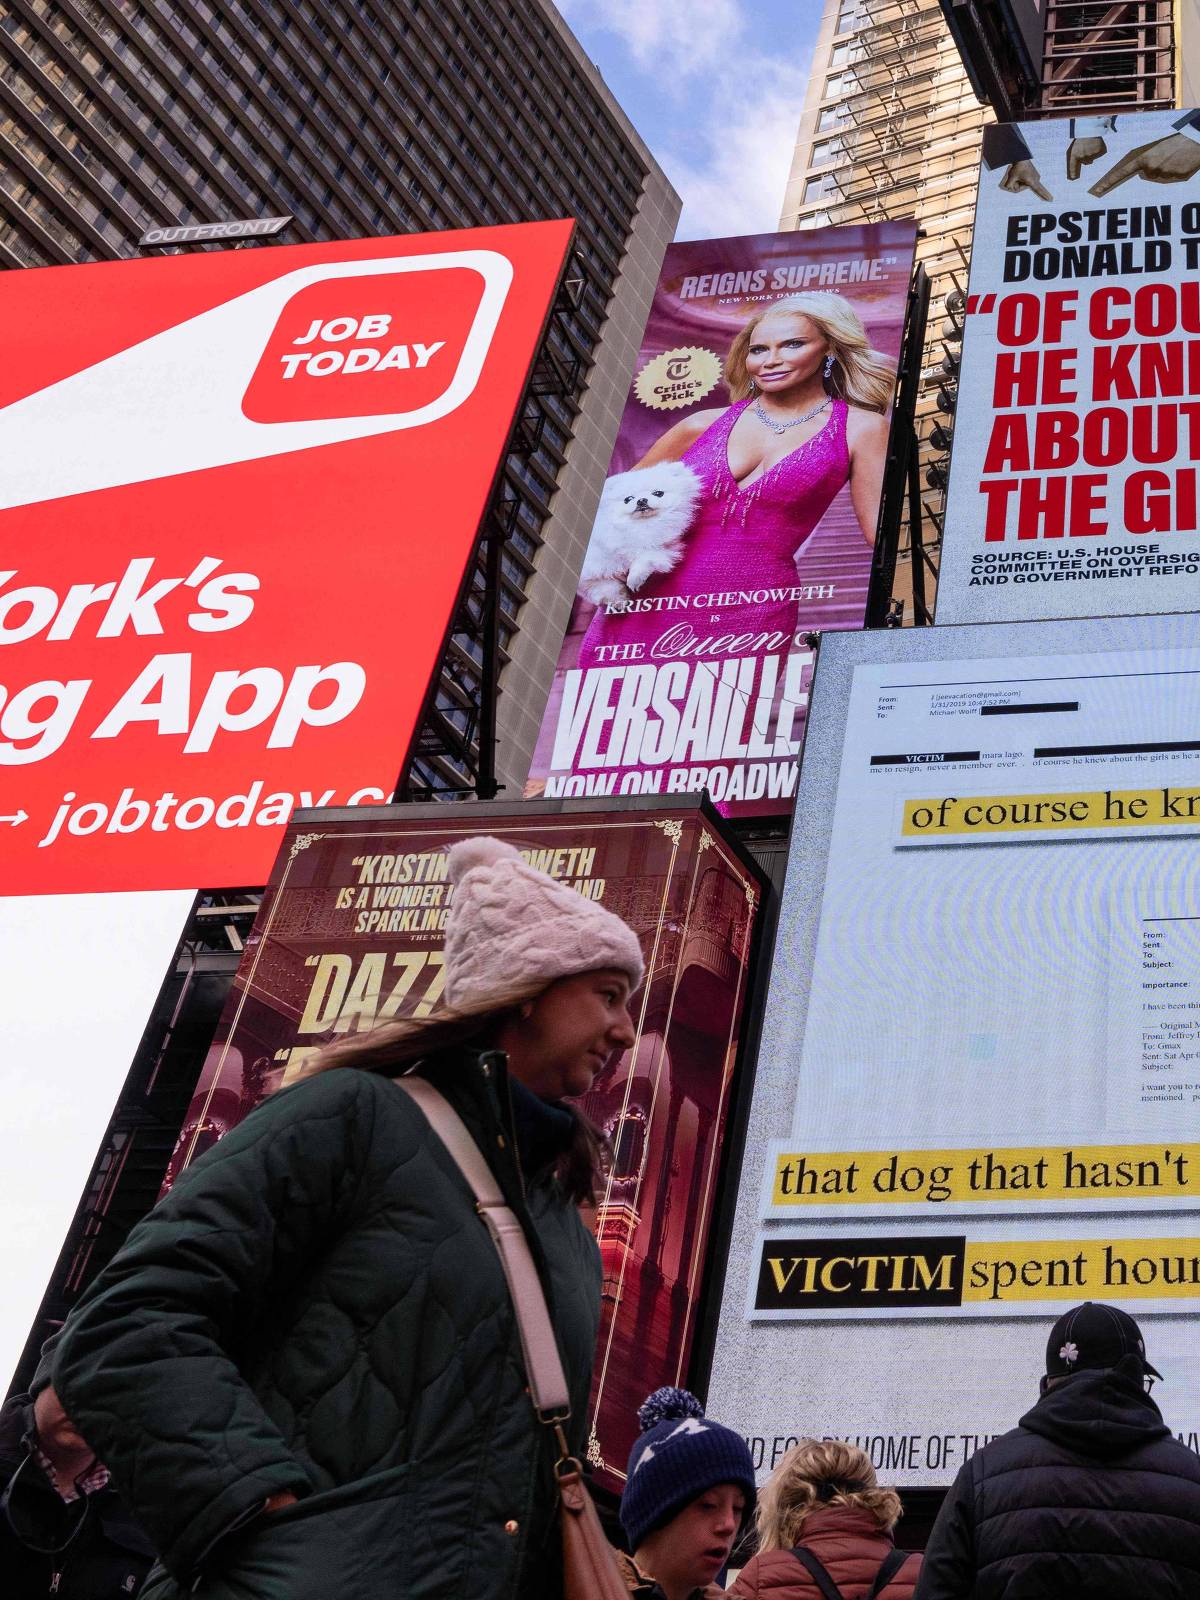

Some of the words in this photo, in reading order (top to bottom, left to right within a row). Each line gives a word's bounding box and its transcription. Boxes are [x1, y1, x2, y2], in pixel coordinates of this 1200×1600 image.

[1006, 205, 1172, 247] EPSTEIN
[1003, 240, 1172, 282] DONALD
[680, 269, 768, 299] REIGNS
[746, 294, 773, 303] YORK
[293, 313, 393, 345] JOB
[966, 290, 1079, 347] “OF
[280, 341, 447, 380] TODAY
[993, 348, 1078, 408] HE
[660, 390, 695, 403] Pick
[979, 473, 1109, 542] THE
[970, 559, 1082, 575] COMMITTEE
[1086, 557, 1113, 567] ON
[972, 550, 1052, 564] SOURCE:
[1057, 547, 1092, 558] U.S.
[1096, 544, 1160, 556] HOUSE
[969, 575, 1009, 586] AND
[1013, 567, 1144, 583] GOVERNMENT
[0, 556, 261, 646] ork’s
[605, 595, 690, 615] KRISTIN
[692, 583, 836, 608] CHENOWETH
[710, 614, 720, 623] IS
[594, 642, 646, 662] THE
[650, 621, 791, 659] Queen
[91, 652, 367, 754] App
[958, 707, 977, 715] Wolff
[905, 754, 945, 763] VICTIM
[958, 762, 993, 770] member
[1072, 757, 1084, 765] he
[1085, 756, 1108, 764] knew
[1109, 755, 1132, 763] about
[1135, 754, 1148, 762] the
[1150, 753, 1169, 763] girls
[544, 772, 619, 798] NOW
[620, 770, 663, 796] ON
[667, 760, 799, 803] BROADW
[911, 797, 957, 828] of
[964, 801, 1089, 826] course
[1103, 791, 1148, 820] he
[335, 889, 355, 909] IS
[355, 887, 367, 908] A
[373, 886, 443, 908] WONDER
[354, 909, 450, 933] SPARKLING
[1142, 961, 1175, 969] Subject:
[1142, 981, 1191, 990] Importance:
[1160, 1022, 1193, 1031] Original
[1167, 1031, 1194, 1040] Jeffrey
[777, 1158, 860, 1195] that
[872, 1155, 954, 1202] dog
[967, 1153, 1050, 1190] that
[1063, 1149, 1189, 1189] hasn't
[765, 1254, 957, 1294] VICTIM
[970, 1251, 1088, 1300] spent
[926, 1435, 956, 1469] OF
